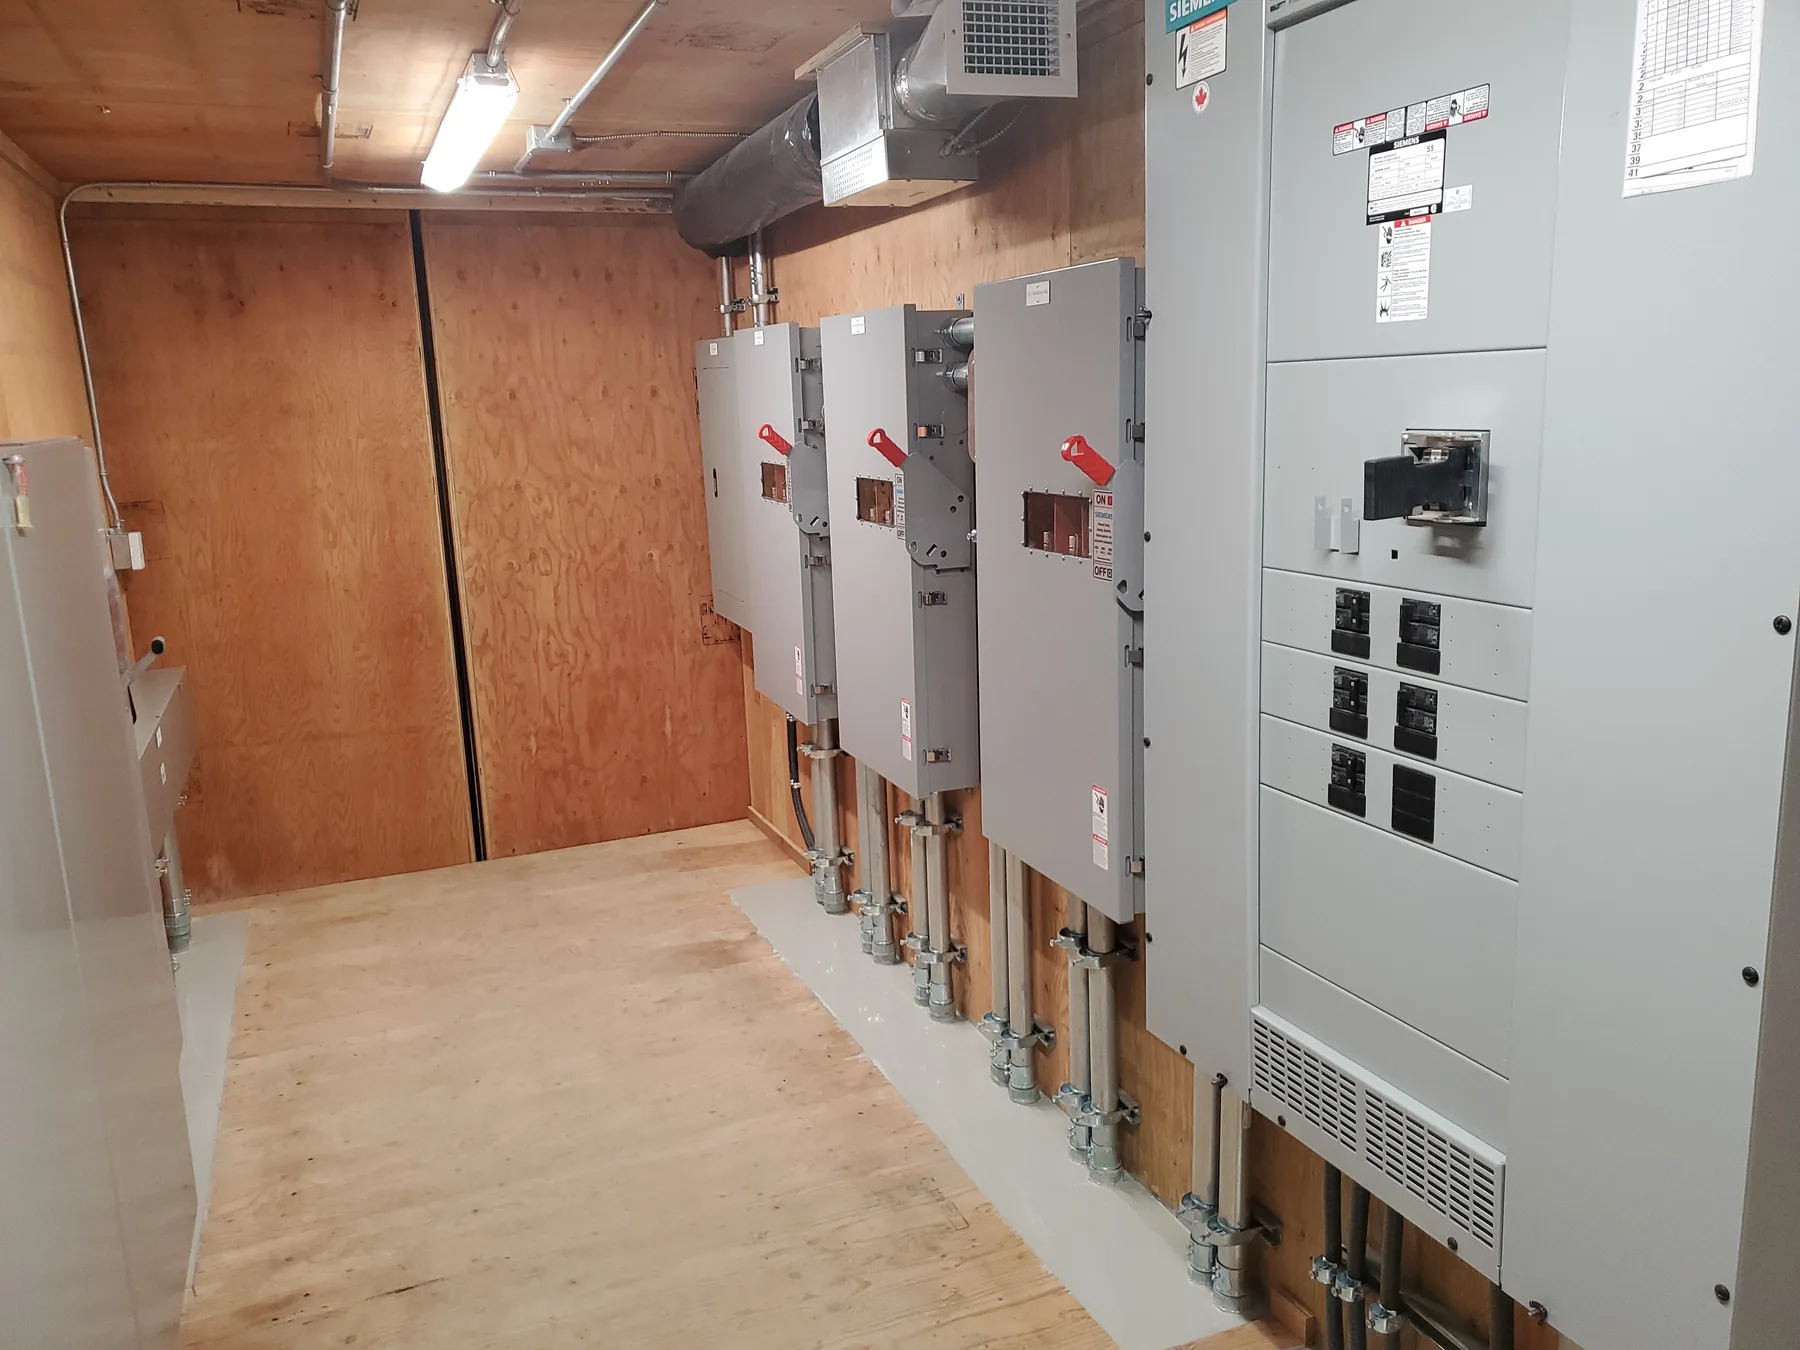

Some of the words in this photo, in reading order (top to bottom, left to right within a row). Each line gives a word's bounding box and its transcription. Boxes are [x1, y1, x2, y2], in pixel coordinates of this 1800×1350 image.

[1169, 0, 1214, 22] SIEM
[1639, 82, 1645, 91] 2
[1637, 95, 1643, 104] 2
[1636, 107, 1641, 116] 3
[1393, 136, 1420, 149] SIEMENS
[1631, 144, 1641, 153] 37
[1630, 156, 1641, 165] 39
[1628, 168, 1639, 177] 41
[1408, 216, 1427, 225] DANGER
[1096, 494, 1106, 505] ON
[1094, 565, 1107, 577] OFF
